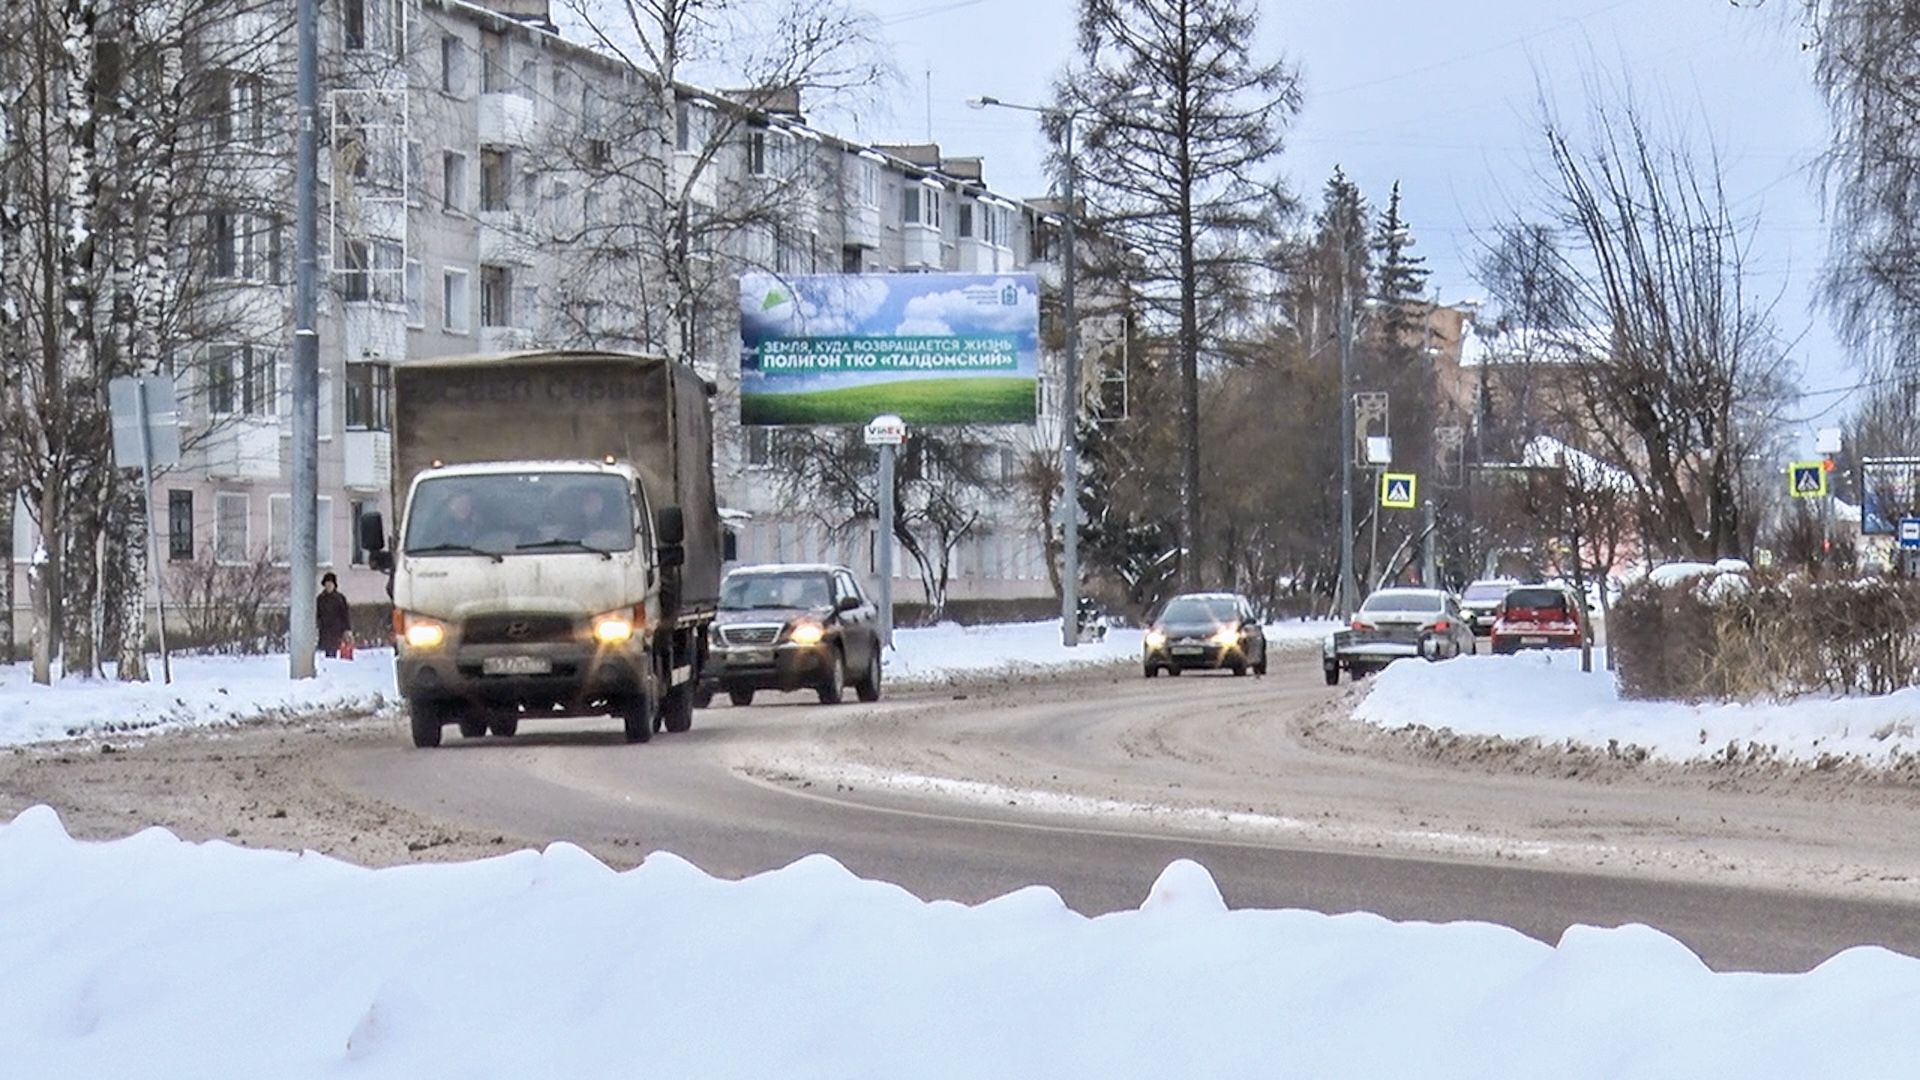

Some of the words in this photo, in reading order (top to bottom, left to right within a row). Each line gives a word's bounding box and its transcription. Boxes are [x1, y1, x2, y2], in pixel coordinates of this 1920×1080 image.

[763, 340, 813, 354] ЗЕМЛЯ,
[815, 340, 851, 354] КУДА
[853, 339, 960, 353] ВОЗВРАЩАЕТСЯ
[964, 339, 1012, 352] ЖИЗНЬ
[763, 353, 841, 368] ПОЛИГОН
[844, 353, 877, 367] ТКО
[880, 350, 1013, 368] «ТАЛДОМСКИЙ»
